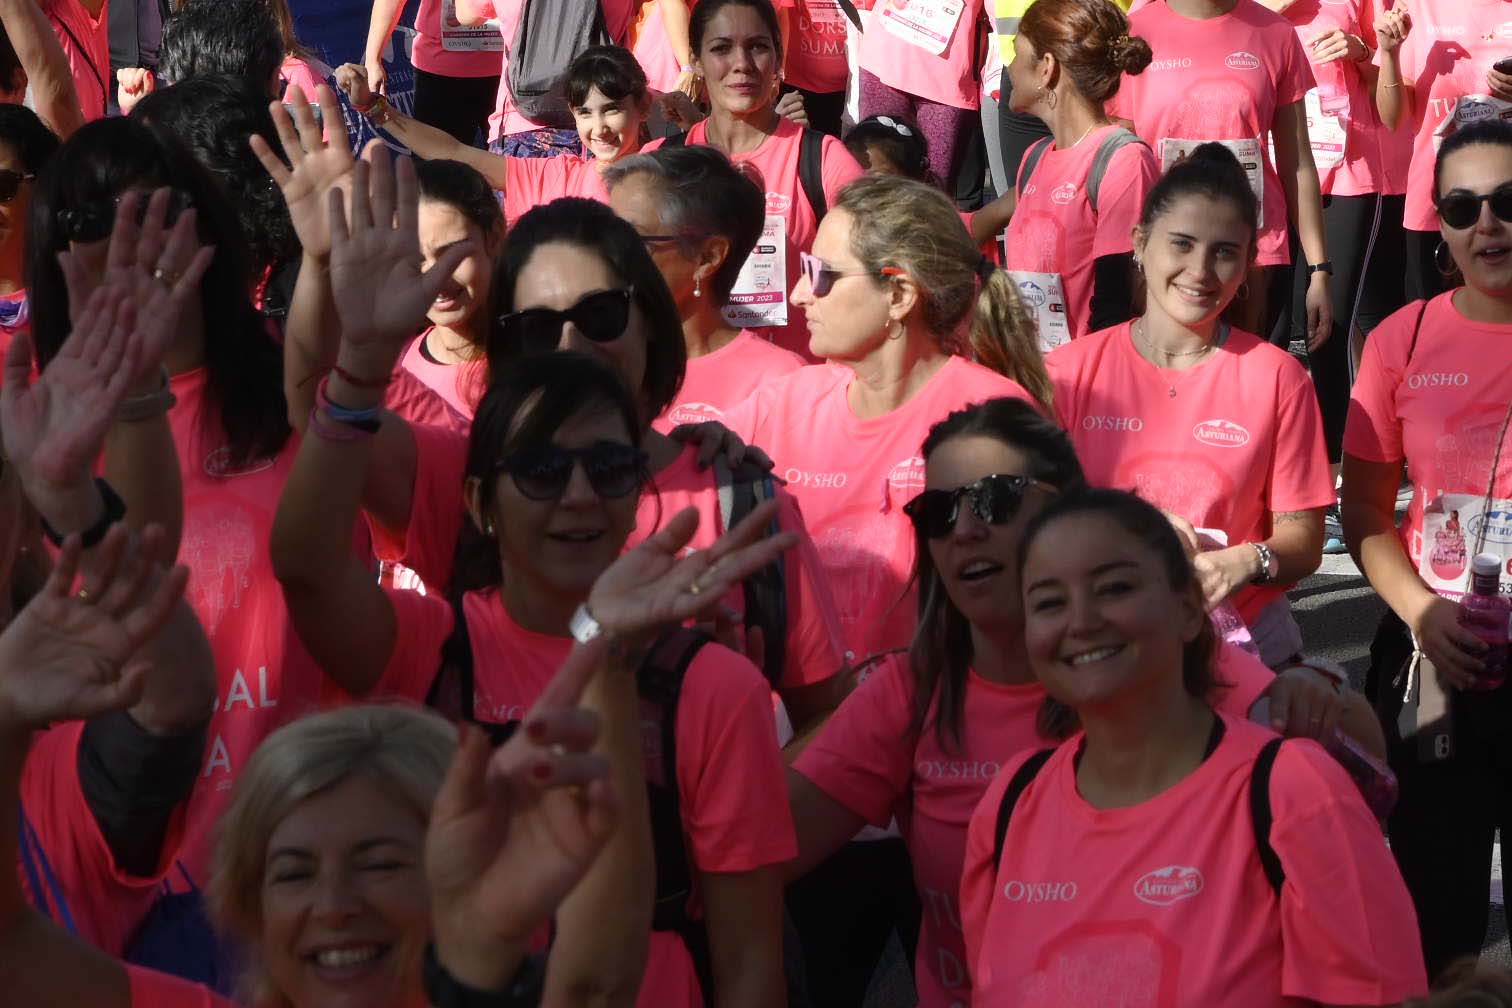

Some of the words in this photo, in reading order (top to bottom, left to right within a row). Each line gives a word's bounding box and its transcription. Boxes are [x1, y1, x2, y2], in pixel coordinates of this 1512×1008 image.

[800, 21, 847, 34] DORS
[729, 294, 755, 304] MUJER
[756, 294, 773, 303] 2023
[1408, 373, 1469, 390] OYSHO
[1082, 415, 1144, 433] OYSHO
[1197, 427, 1246, 443] ASTURIANA
[785, 467, 848, 489] OYSHO
[915, 760, 1001, 780] OYSHO
[1004, 880, 1078, 904] OYSHO
